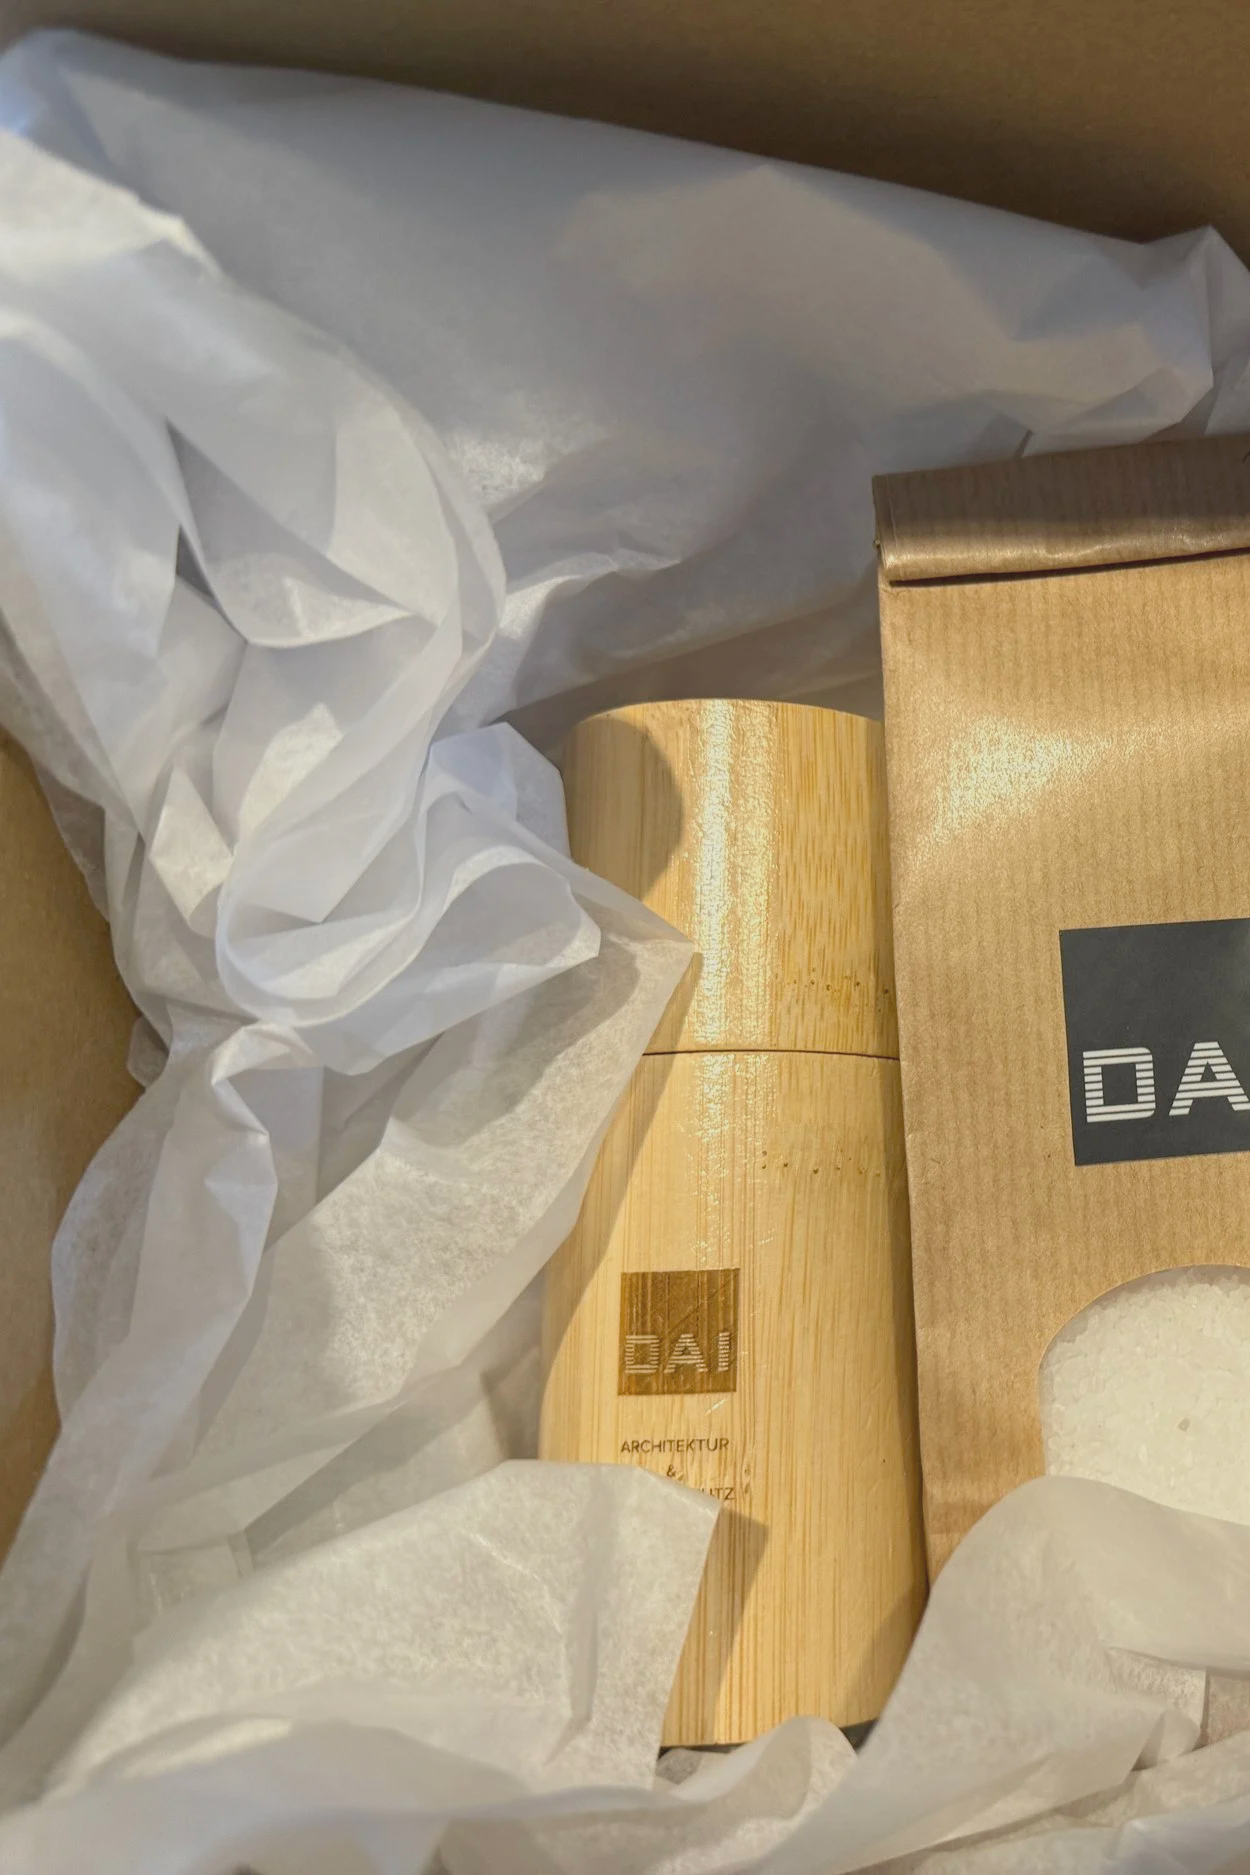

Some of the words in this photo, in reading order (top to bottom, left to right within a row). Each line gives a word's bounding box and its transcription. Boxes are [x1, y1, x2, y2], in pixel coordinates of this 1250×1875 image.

[624, 1331, 731, 1374] DAI
[620, 1437, 730, 1454] ARCHITEKTUR
[666, 1464, 677, 1478] &
